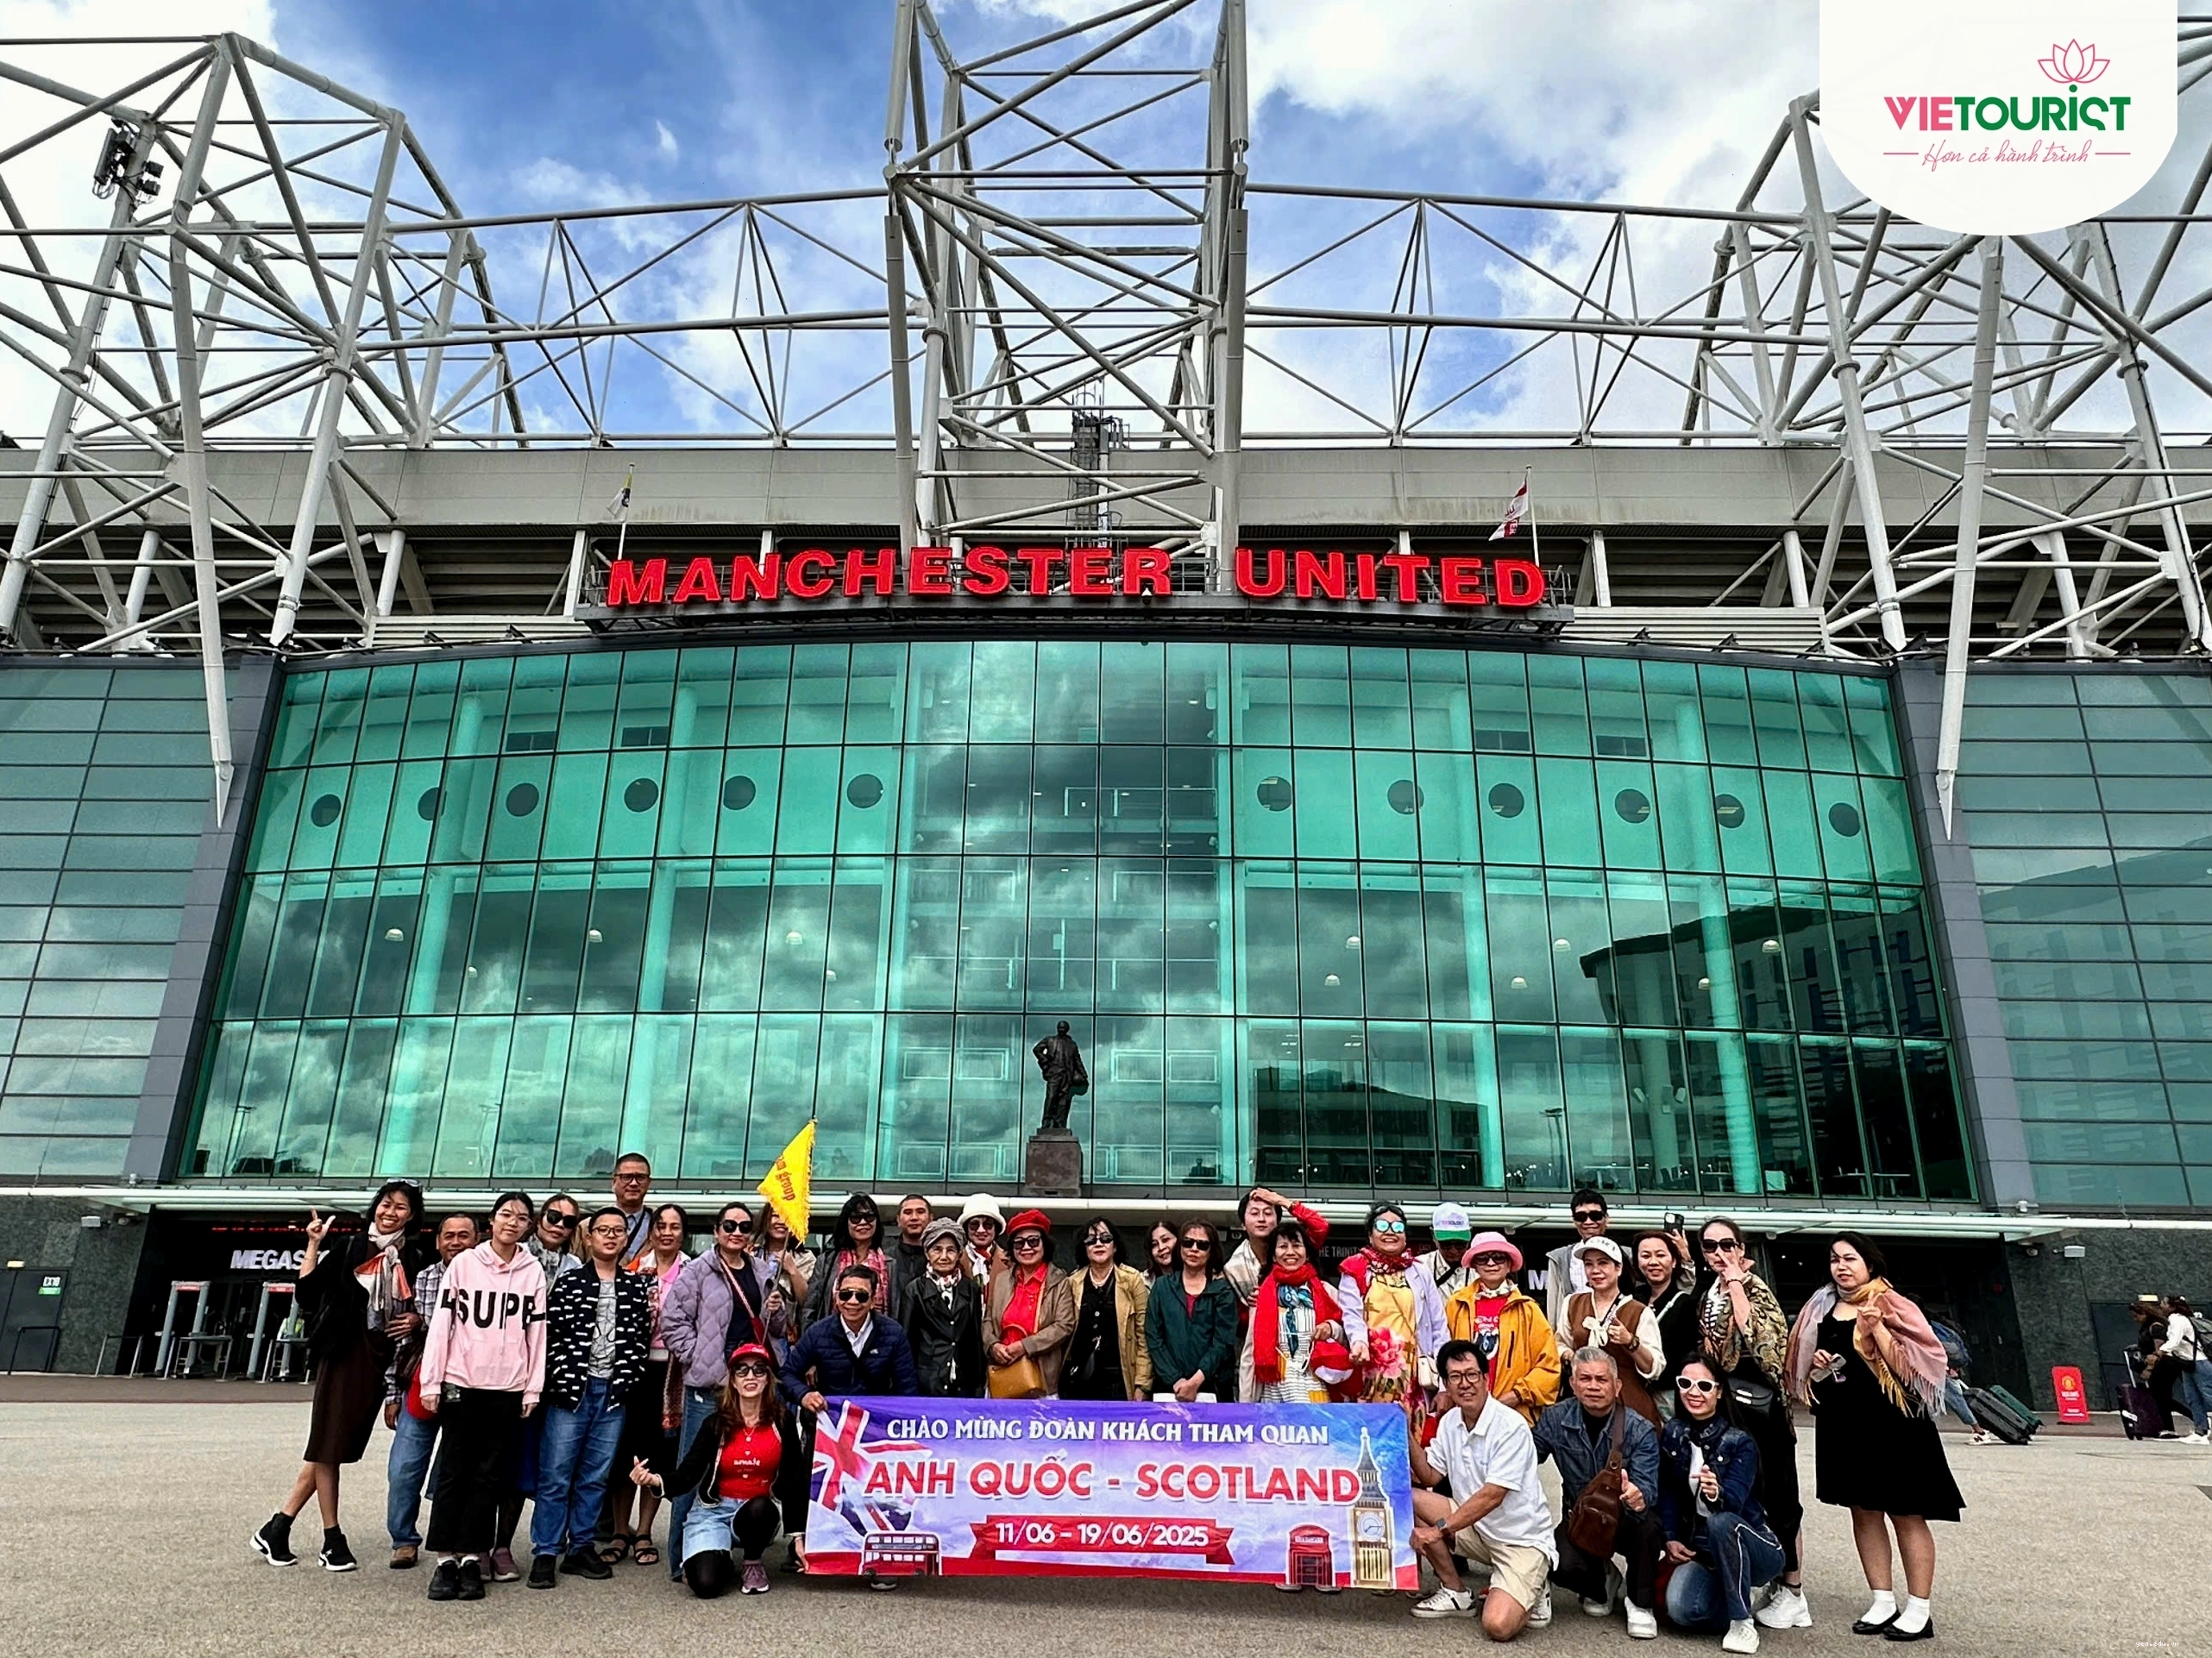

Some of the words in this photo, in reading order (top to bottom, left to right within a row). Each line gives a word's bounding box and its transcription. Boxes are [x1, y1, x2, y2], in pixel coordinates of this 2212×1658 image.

[606, 546, 1172, 606] MANCHESTER
[1235, 547, 1546, 607] UNITED
[229, 1249, 330, 1270] MEGAS
[887, 1415, 949, 1439] CHÀO
[955, 1416, 1022, 1440] MỪNG
[1028, 1416, 1095, 1440] ĐOÀN
[1102, 1418, 1182, 1441] KHÁCH
[1188, 1422, 1254, 1443] THAM
[1260, 1424, 1329, 1447] QUAN
[864, 1460, 956, 1495] ANH
[969, 1449, 1093, 1498] QUỐC
[1135, 1462, 1361, 1503] SCOTLAND
[995, 1519, 1056, 1545] 11/06
[1078, 1521, 1209, 1548] 19/06/2025
